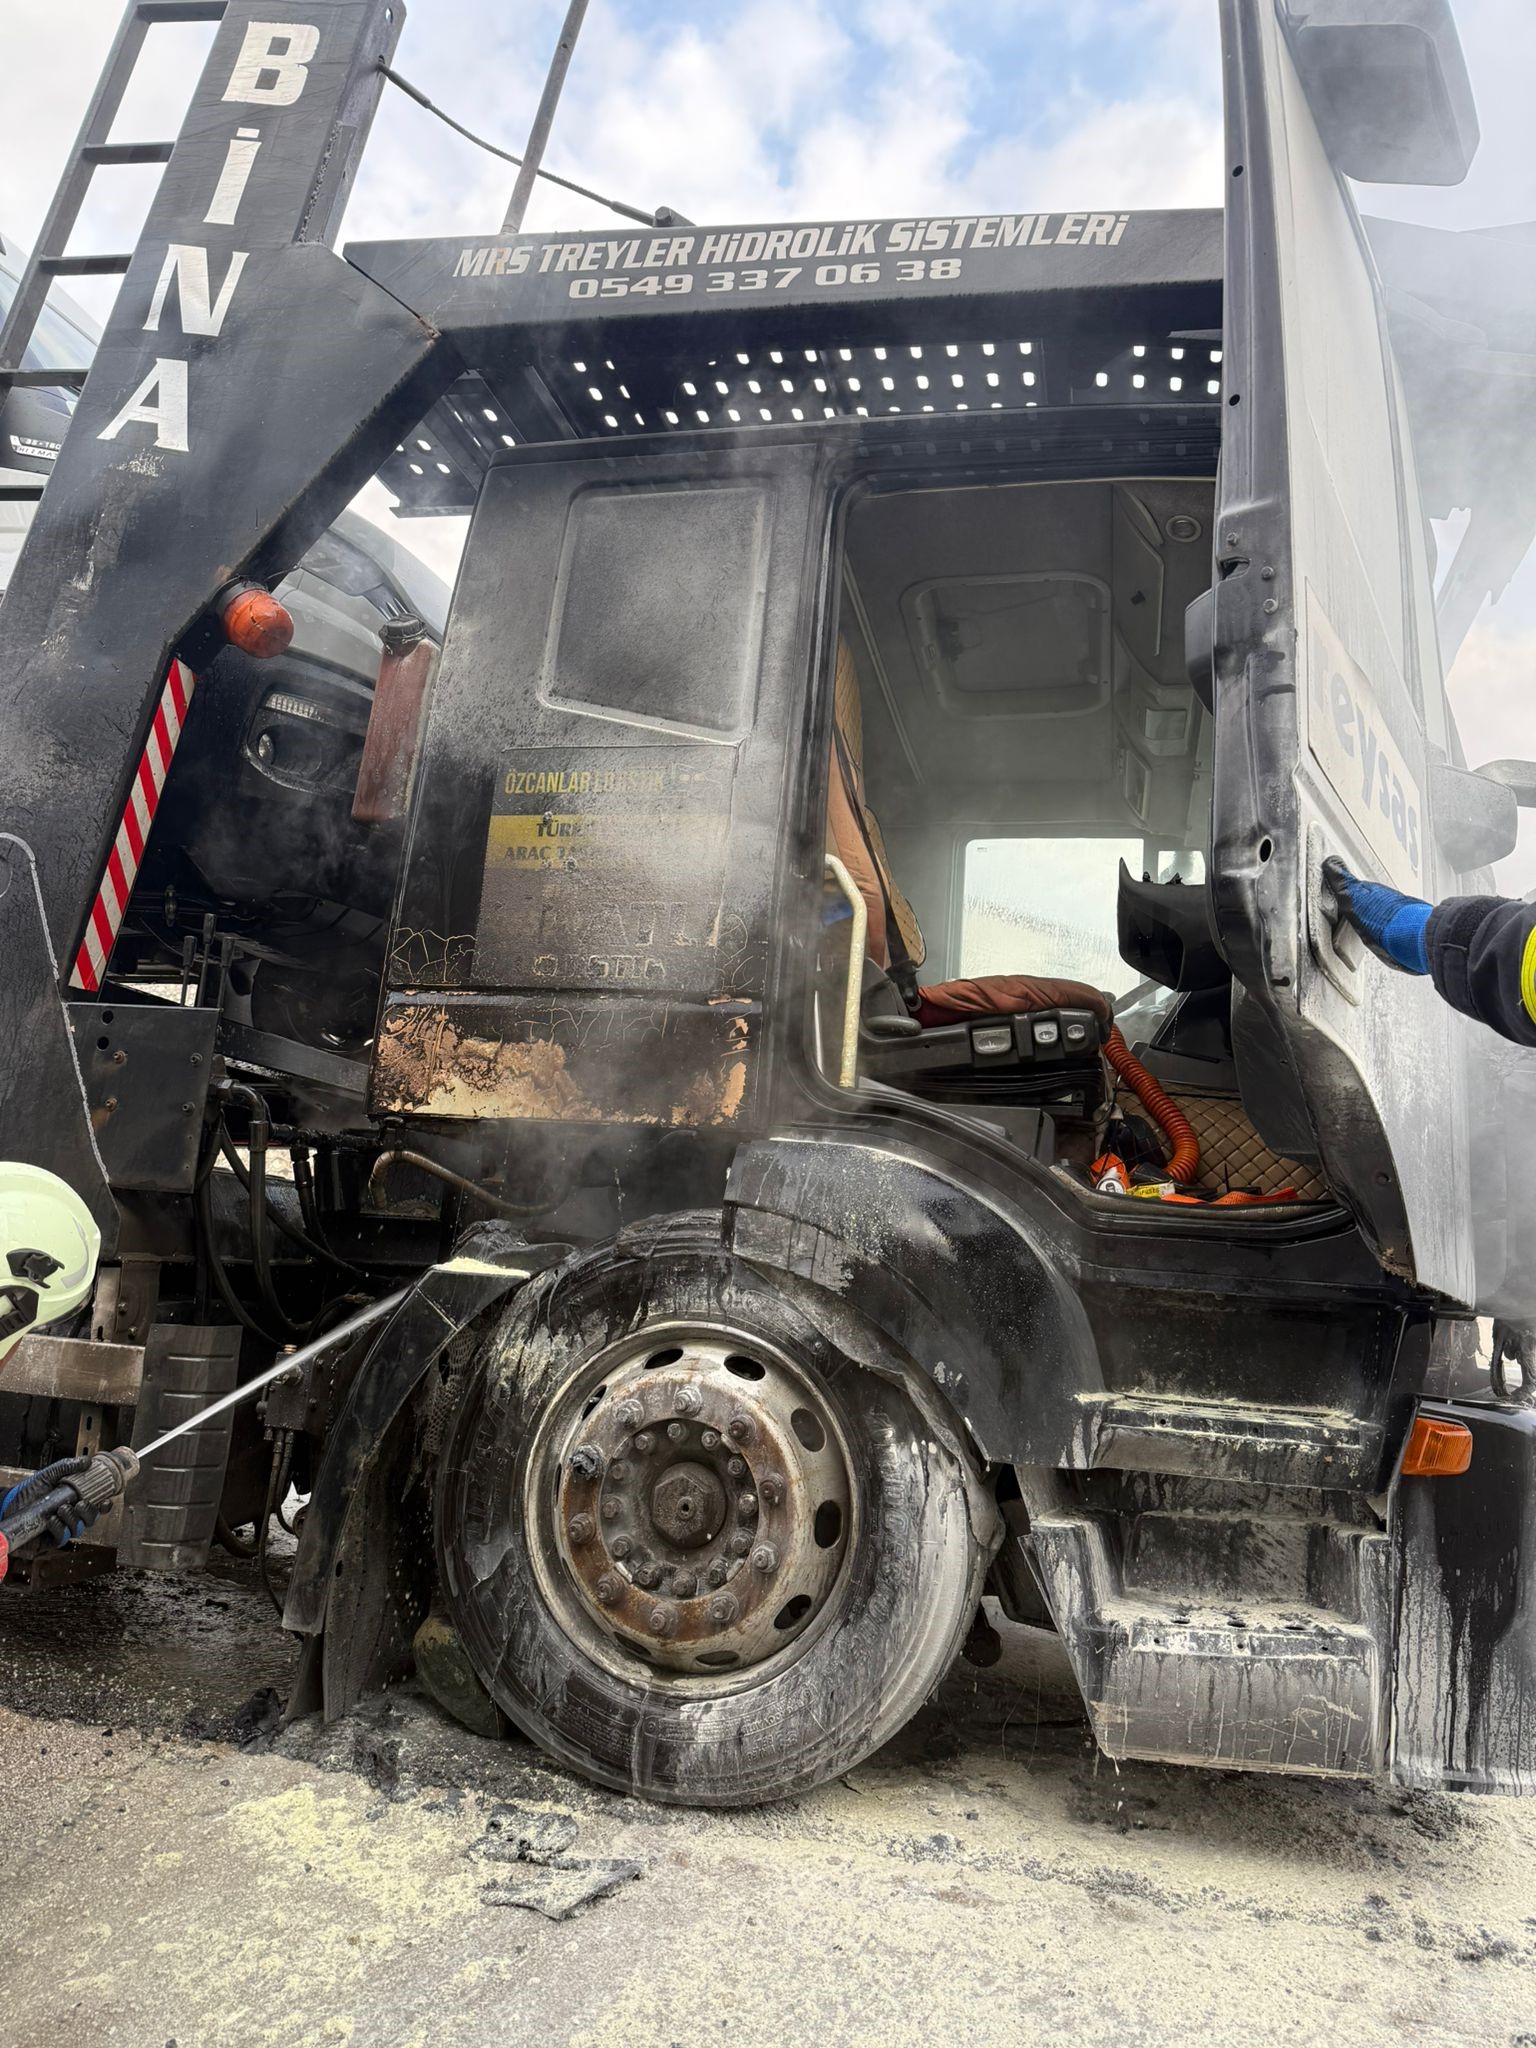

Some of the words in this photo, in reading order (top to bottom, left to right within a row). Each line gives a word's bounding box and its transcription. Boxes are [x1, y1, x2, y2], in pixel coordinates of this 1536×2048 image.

[452, 246, 533, 277] MRS
[538, 237, 695, 273] TREYLER
[569, 274, 693, 299] 0549
[706, 267, 803, 293] 337
[815, 262, 881, 286] 06
[896, 258, 962, 282] 38
[504, 769, 590, 795] ÖZCANLAR
